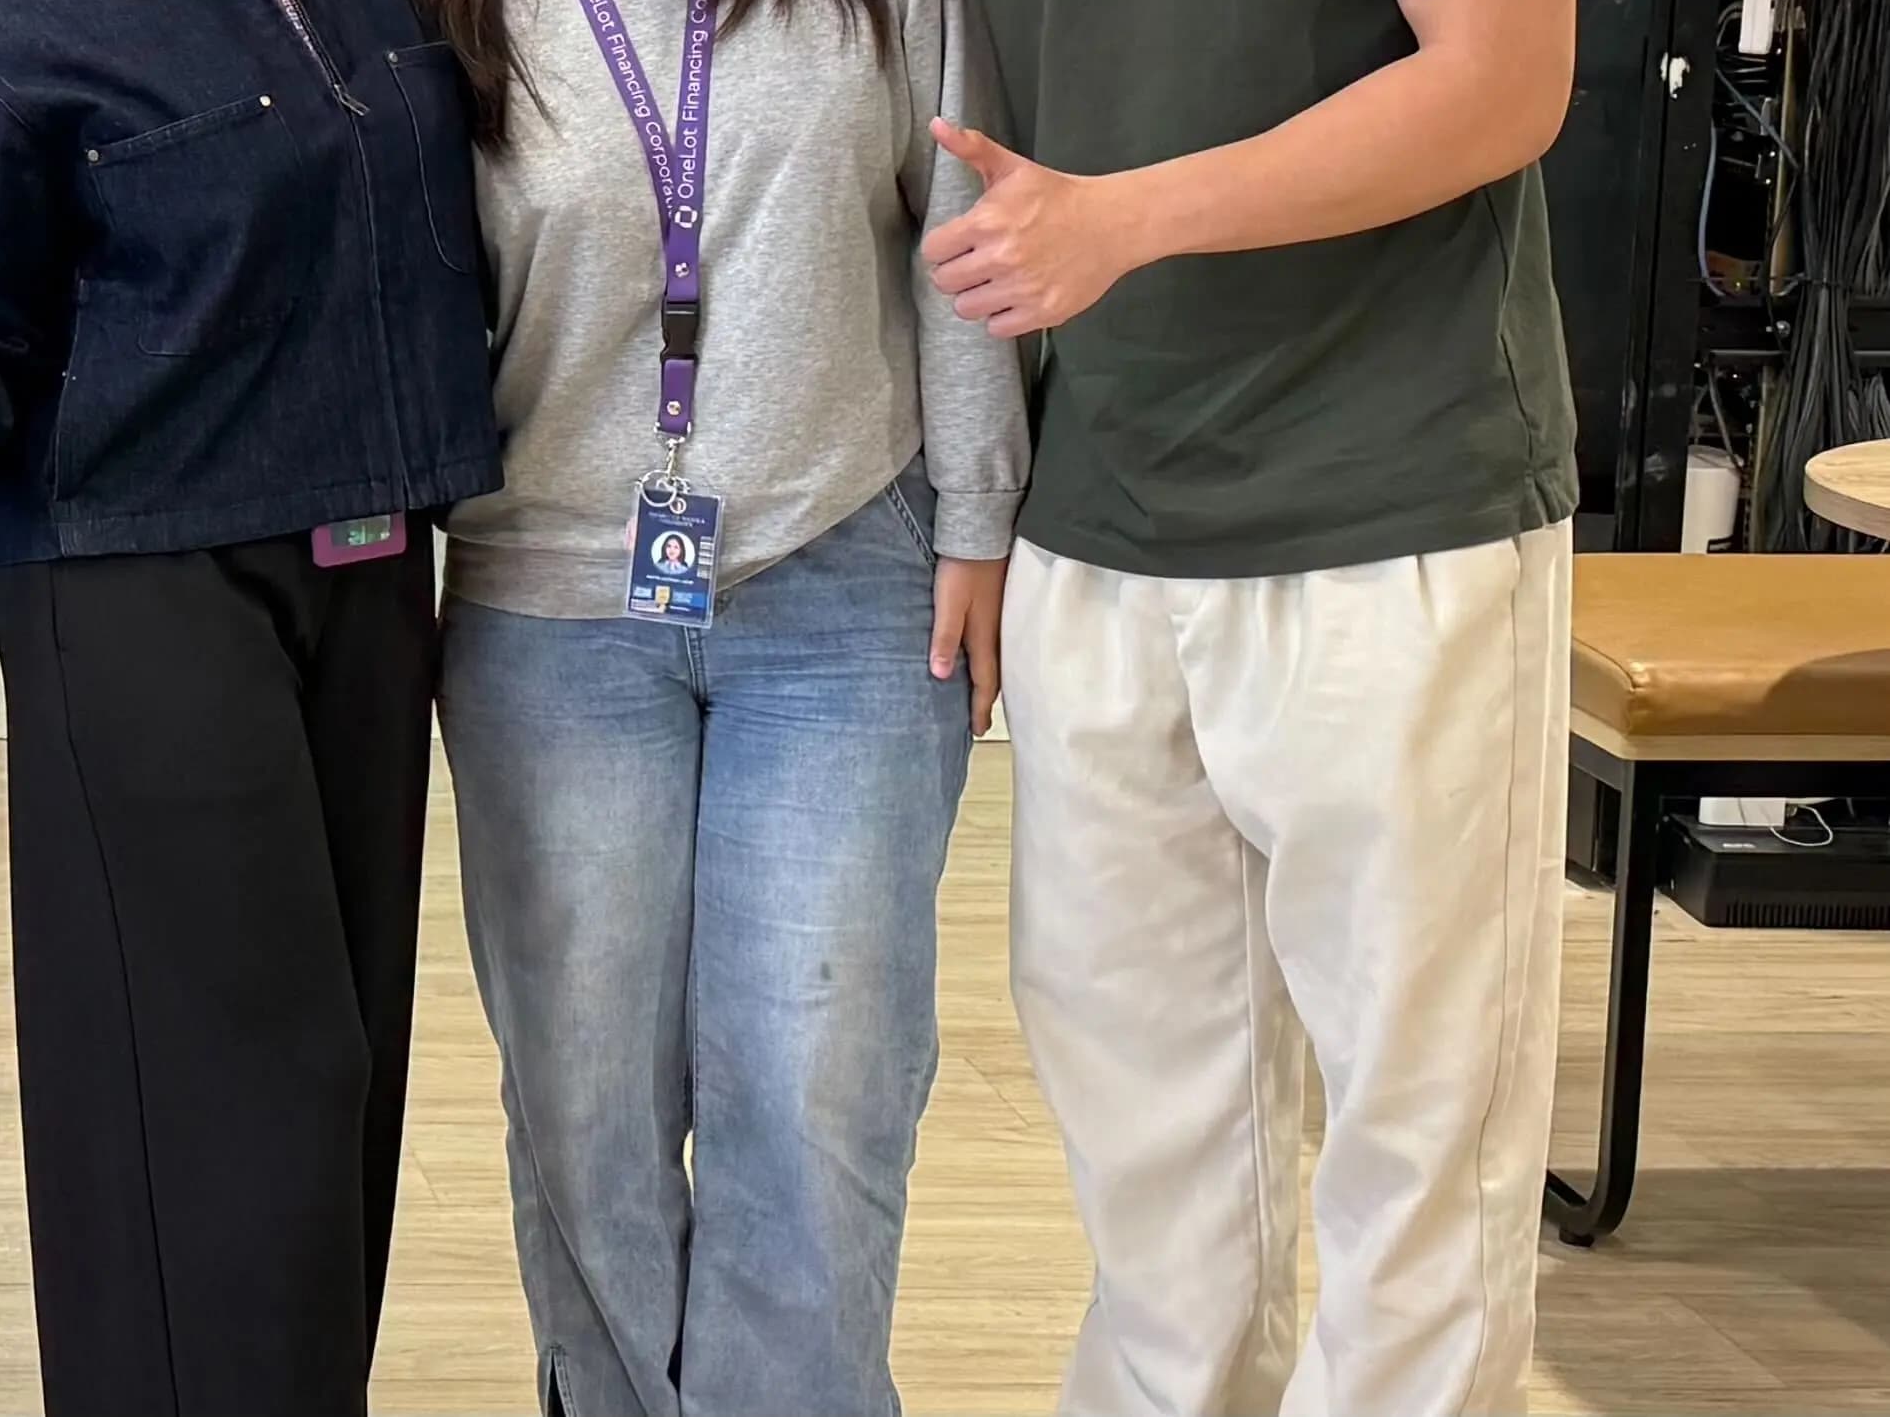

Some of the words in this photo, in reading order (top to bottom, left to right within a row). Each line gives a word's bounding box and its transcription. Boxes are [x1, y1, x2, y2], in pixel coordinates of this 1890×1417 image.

[606, 32, 651, 119] Financing
[681, 29, 709, 122] Financing
[677, 127, 699, 199] OneLot
